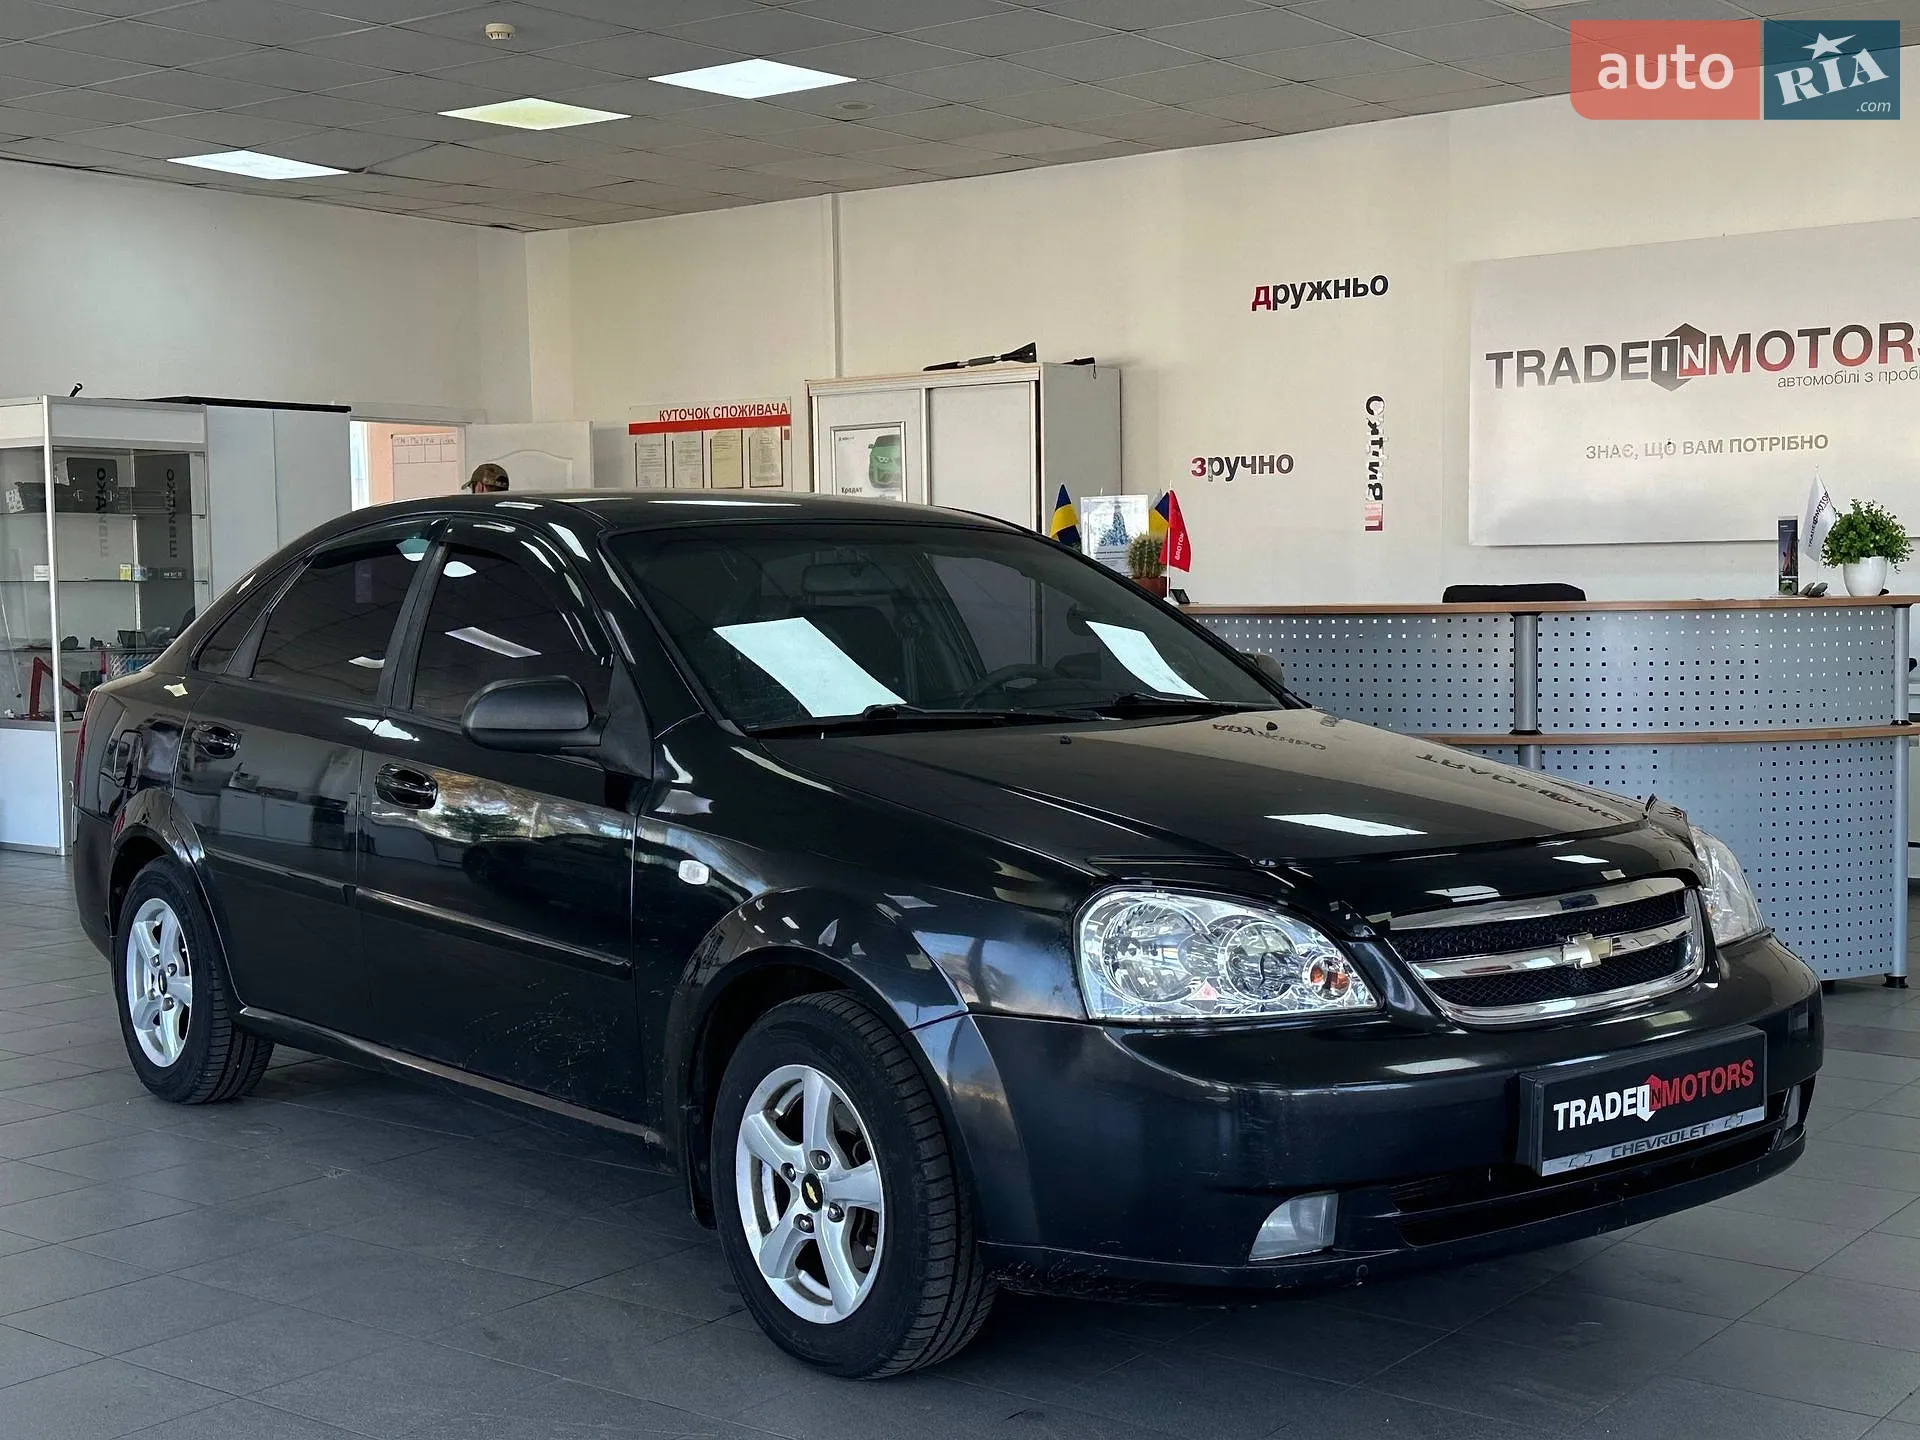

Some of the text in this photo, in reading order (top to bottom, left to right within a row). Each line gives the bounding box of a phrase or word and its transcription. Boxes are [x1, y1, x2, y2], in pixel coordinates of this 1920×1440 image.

[1251, 274, 1389, 311] дружньо
[1485, 321, 1920, 392] TRADEINMOTOR
[1777, 369, 1860, 388] автомобілі
[1864, 371, 1874, 383] з
[659, 403, 788, 422] КУТОЧОК СПОЖИВАЧА
[1644, 440, 1677, 459] ЩО
[1683, 439, 1723, 455] ВАМ
[1729, 434, 1829, 453] ПОТРІБНО
[1191, 453, 1295, 482] зручно
[1611, 1123, 1708, 1158] CHEVROLET
